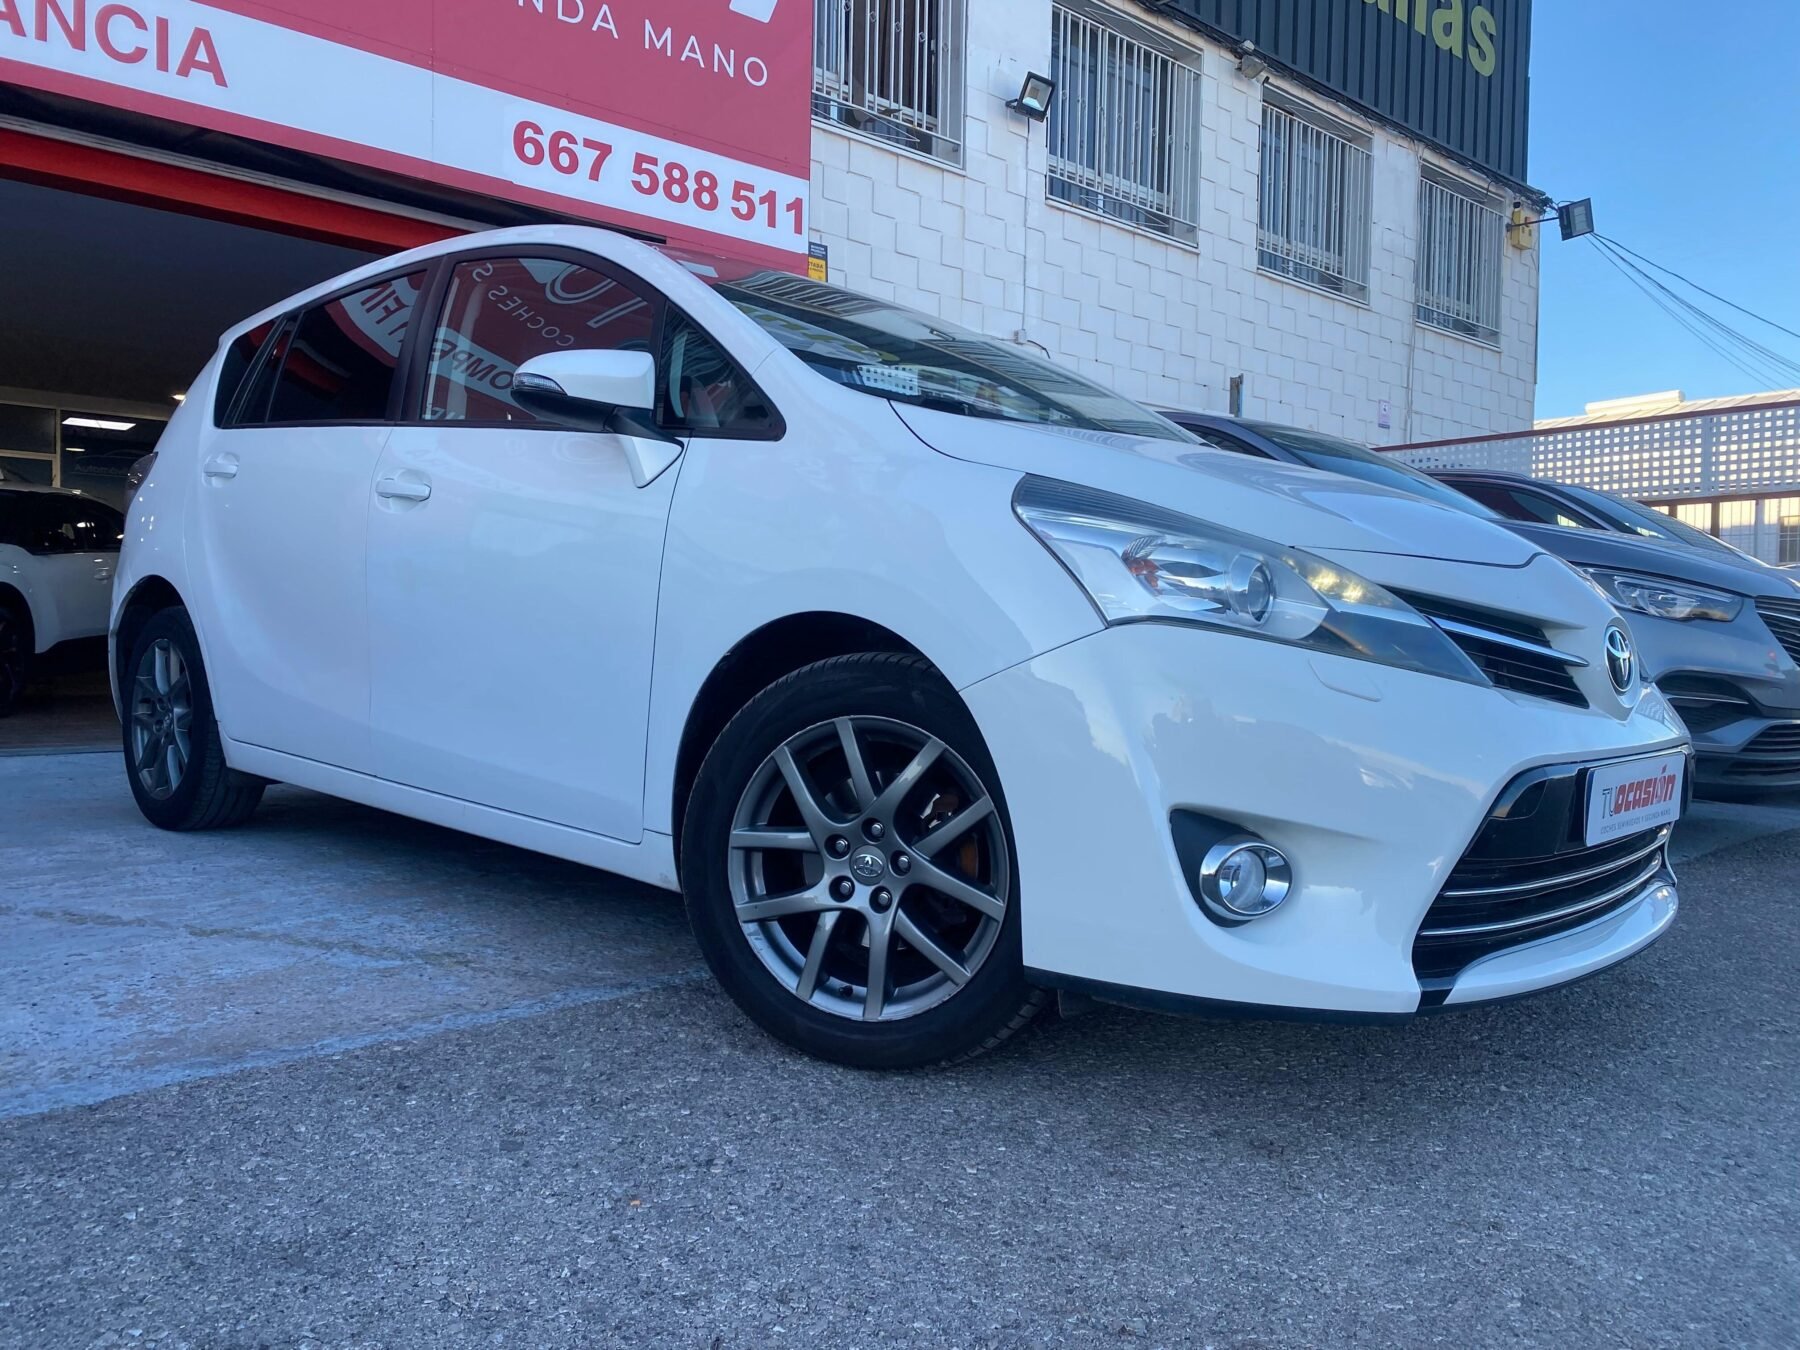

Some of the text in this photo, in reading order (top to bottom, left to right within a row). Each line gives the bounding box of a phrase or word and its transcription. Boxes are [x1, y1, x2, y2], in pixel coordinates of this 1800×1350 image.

[643, 18, 769, 87] MANO
[512, 120, 804, 235] 667 588 511
